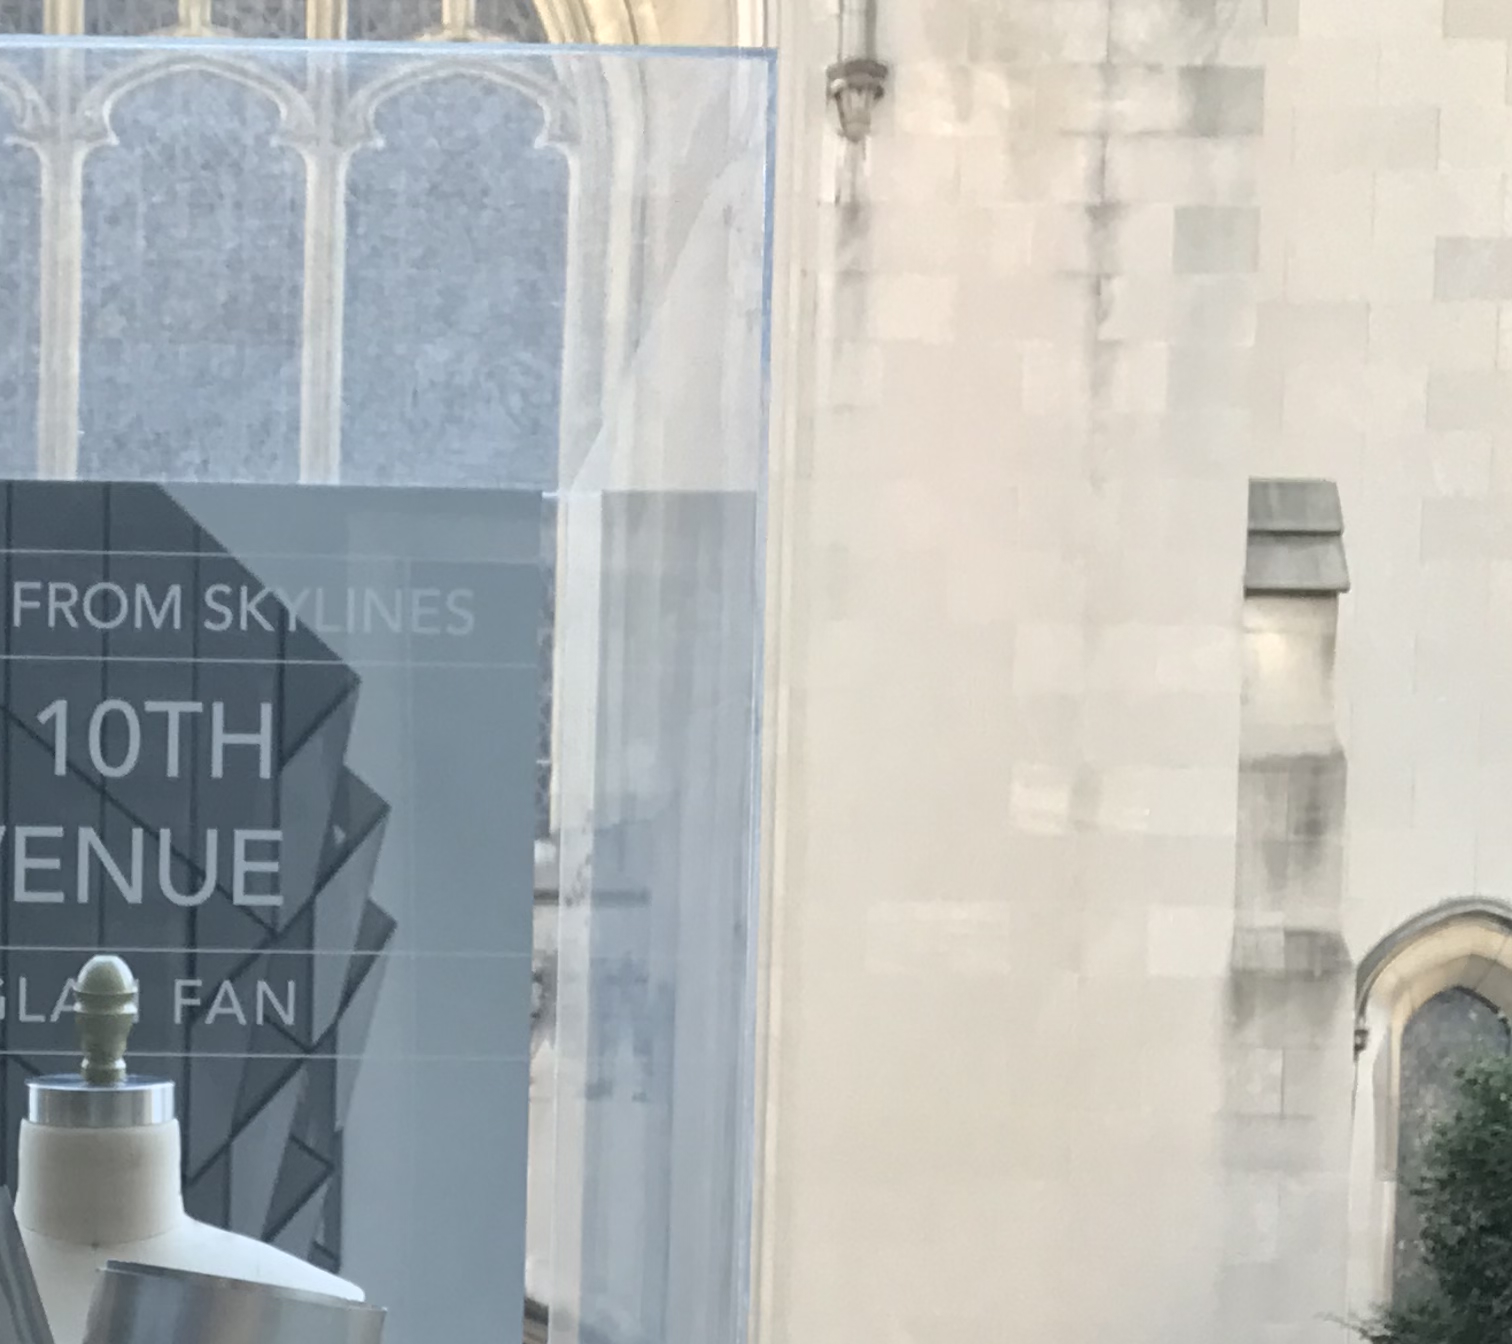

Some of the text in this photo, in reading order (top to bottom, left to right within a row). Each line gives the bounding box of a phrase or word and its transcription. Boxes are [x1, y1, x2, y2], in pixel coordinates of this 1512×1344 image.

[13, 580, 181, 630] FROM
[203, 583, 475, 635] SKYLINES
[36, 698, 272, 780] 10TH
[174, 978, 295, 1026] FAN
